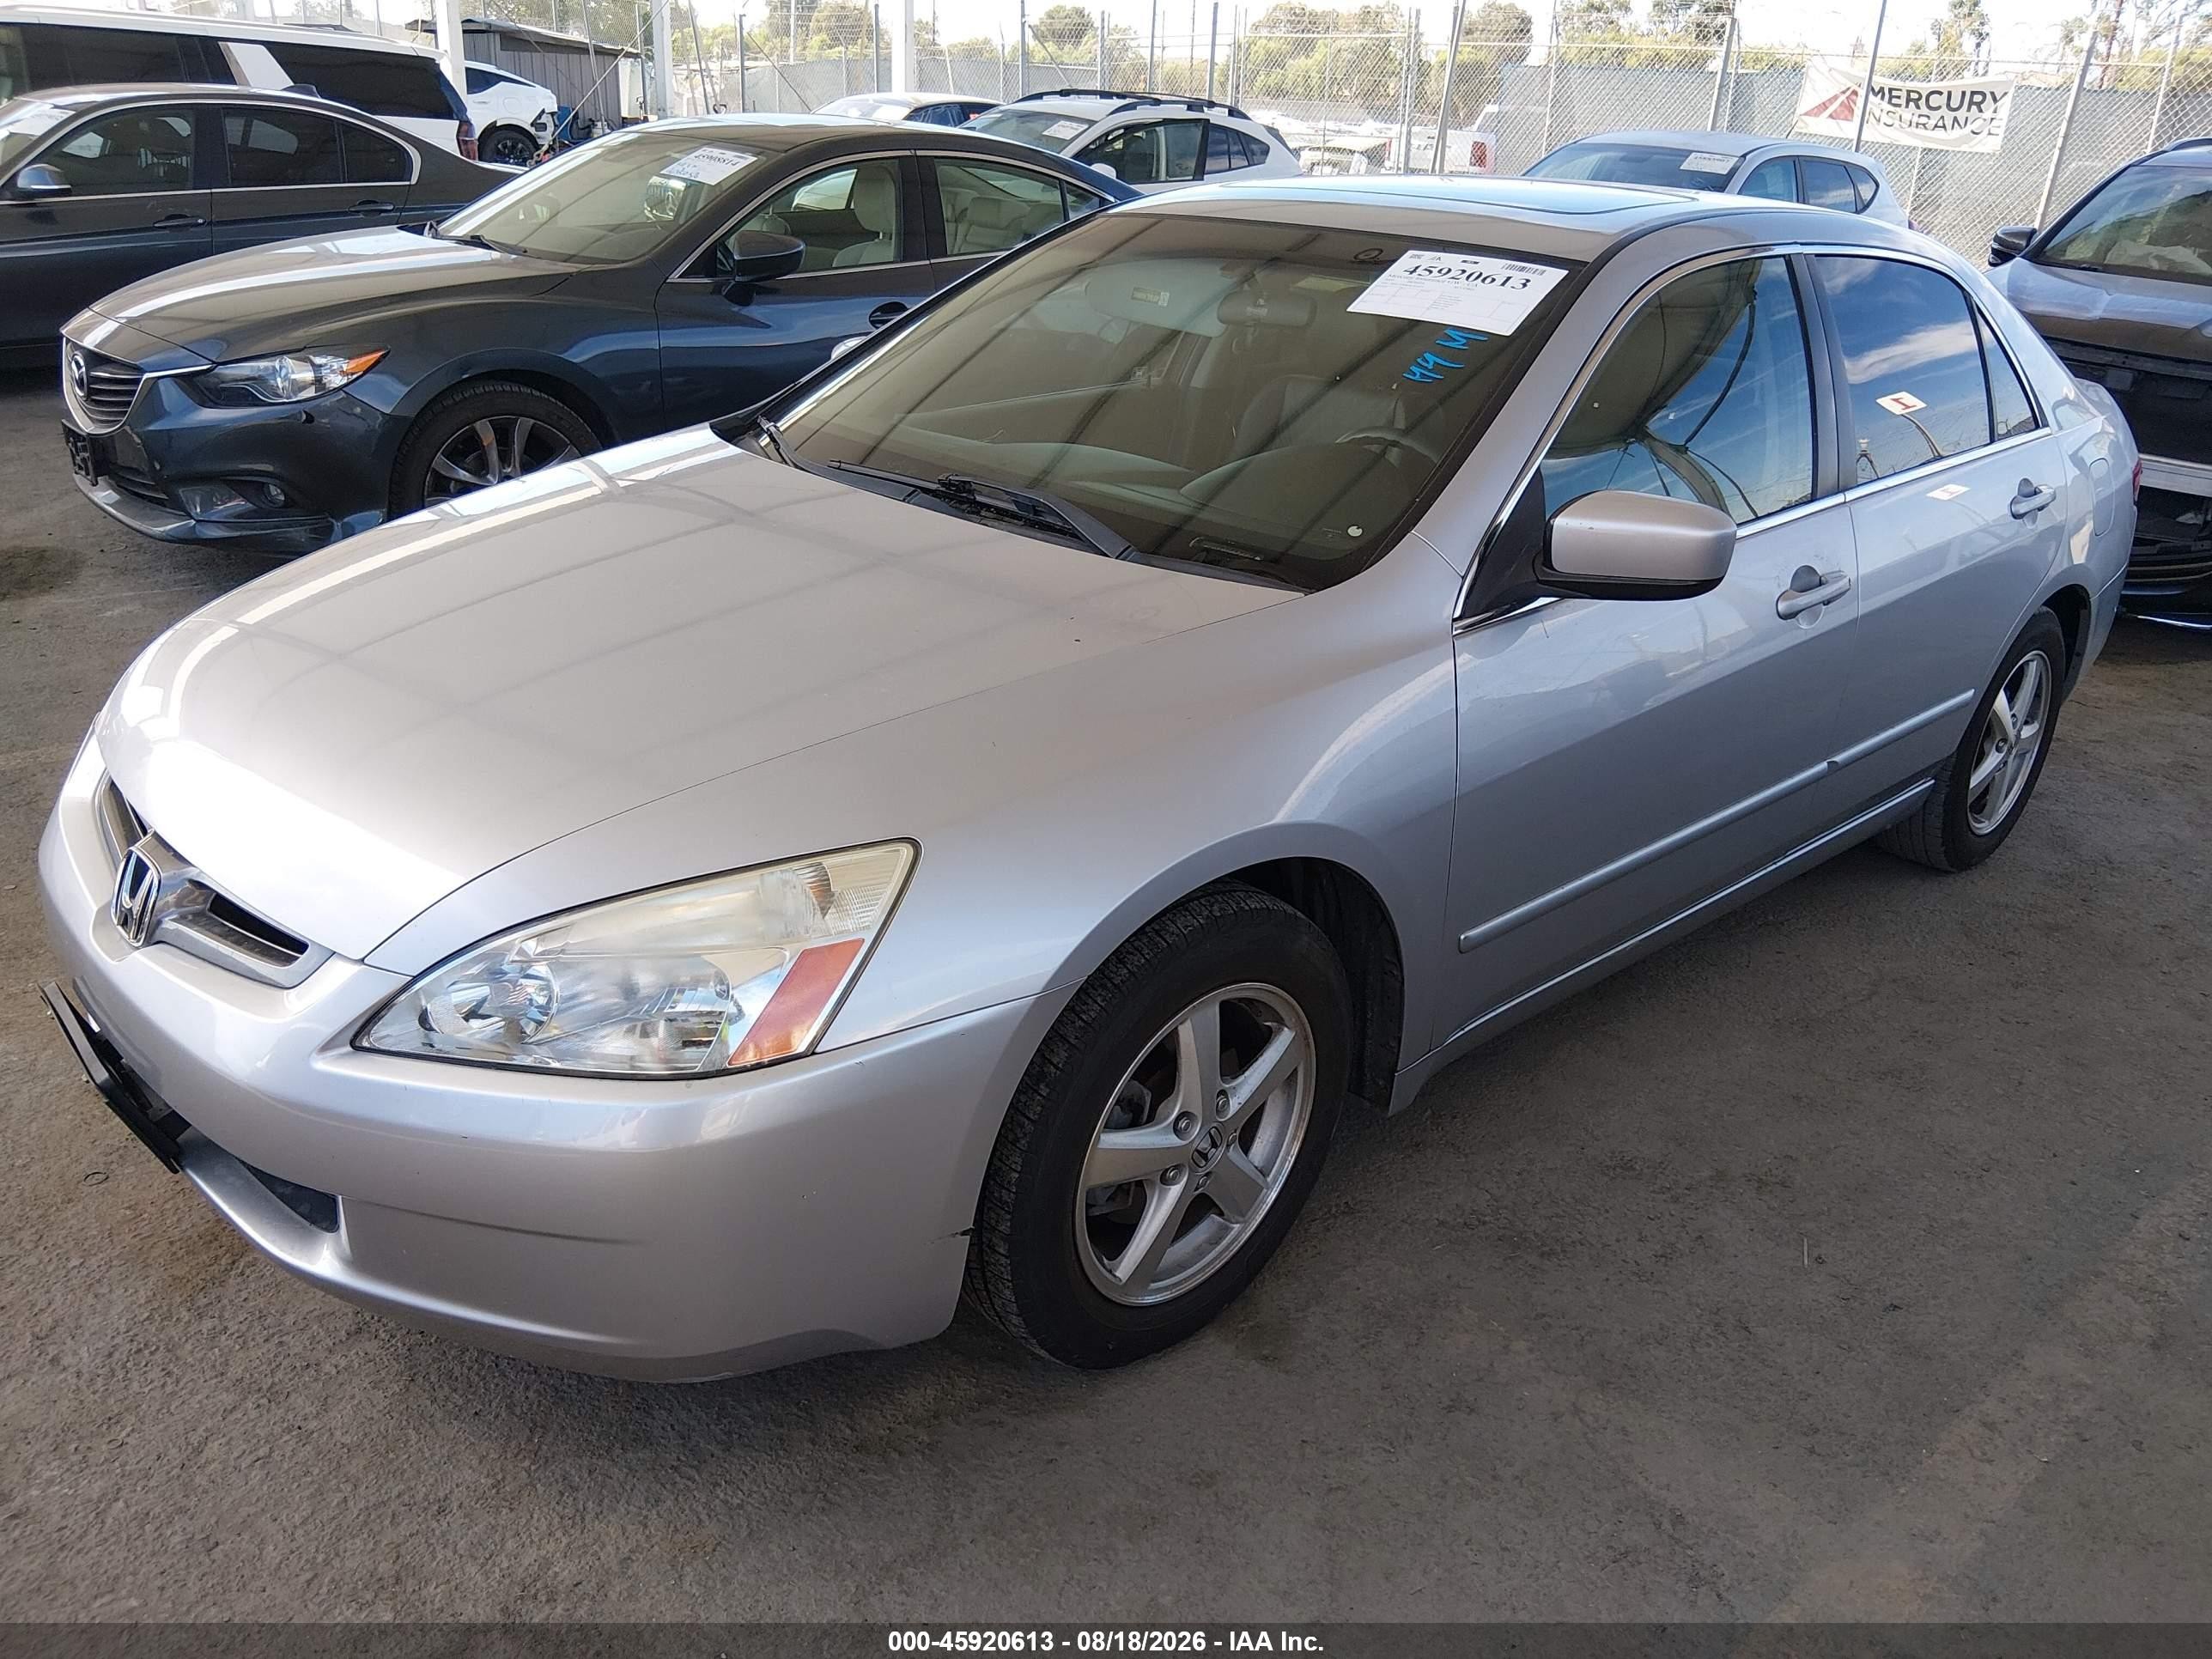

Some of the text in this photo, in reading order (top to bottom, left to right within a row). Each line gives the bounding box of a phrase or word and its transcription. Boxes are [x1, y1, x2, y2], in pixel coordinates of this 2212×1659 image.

[1869, 86, 2009, 114] MERCURY
[1866, 108, 2001, 136] NSURANCE
[1402, 264, 1532, 290] 45920613
